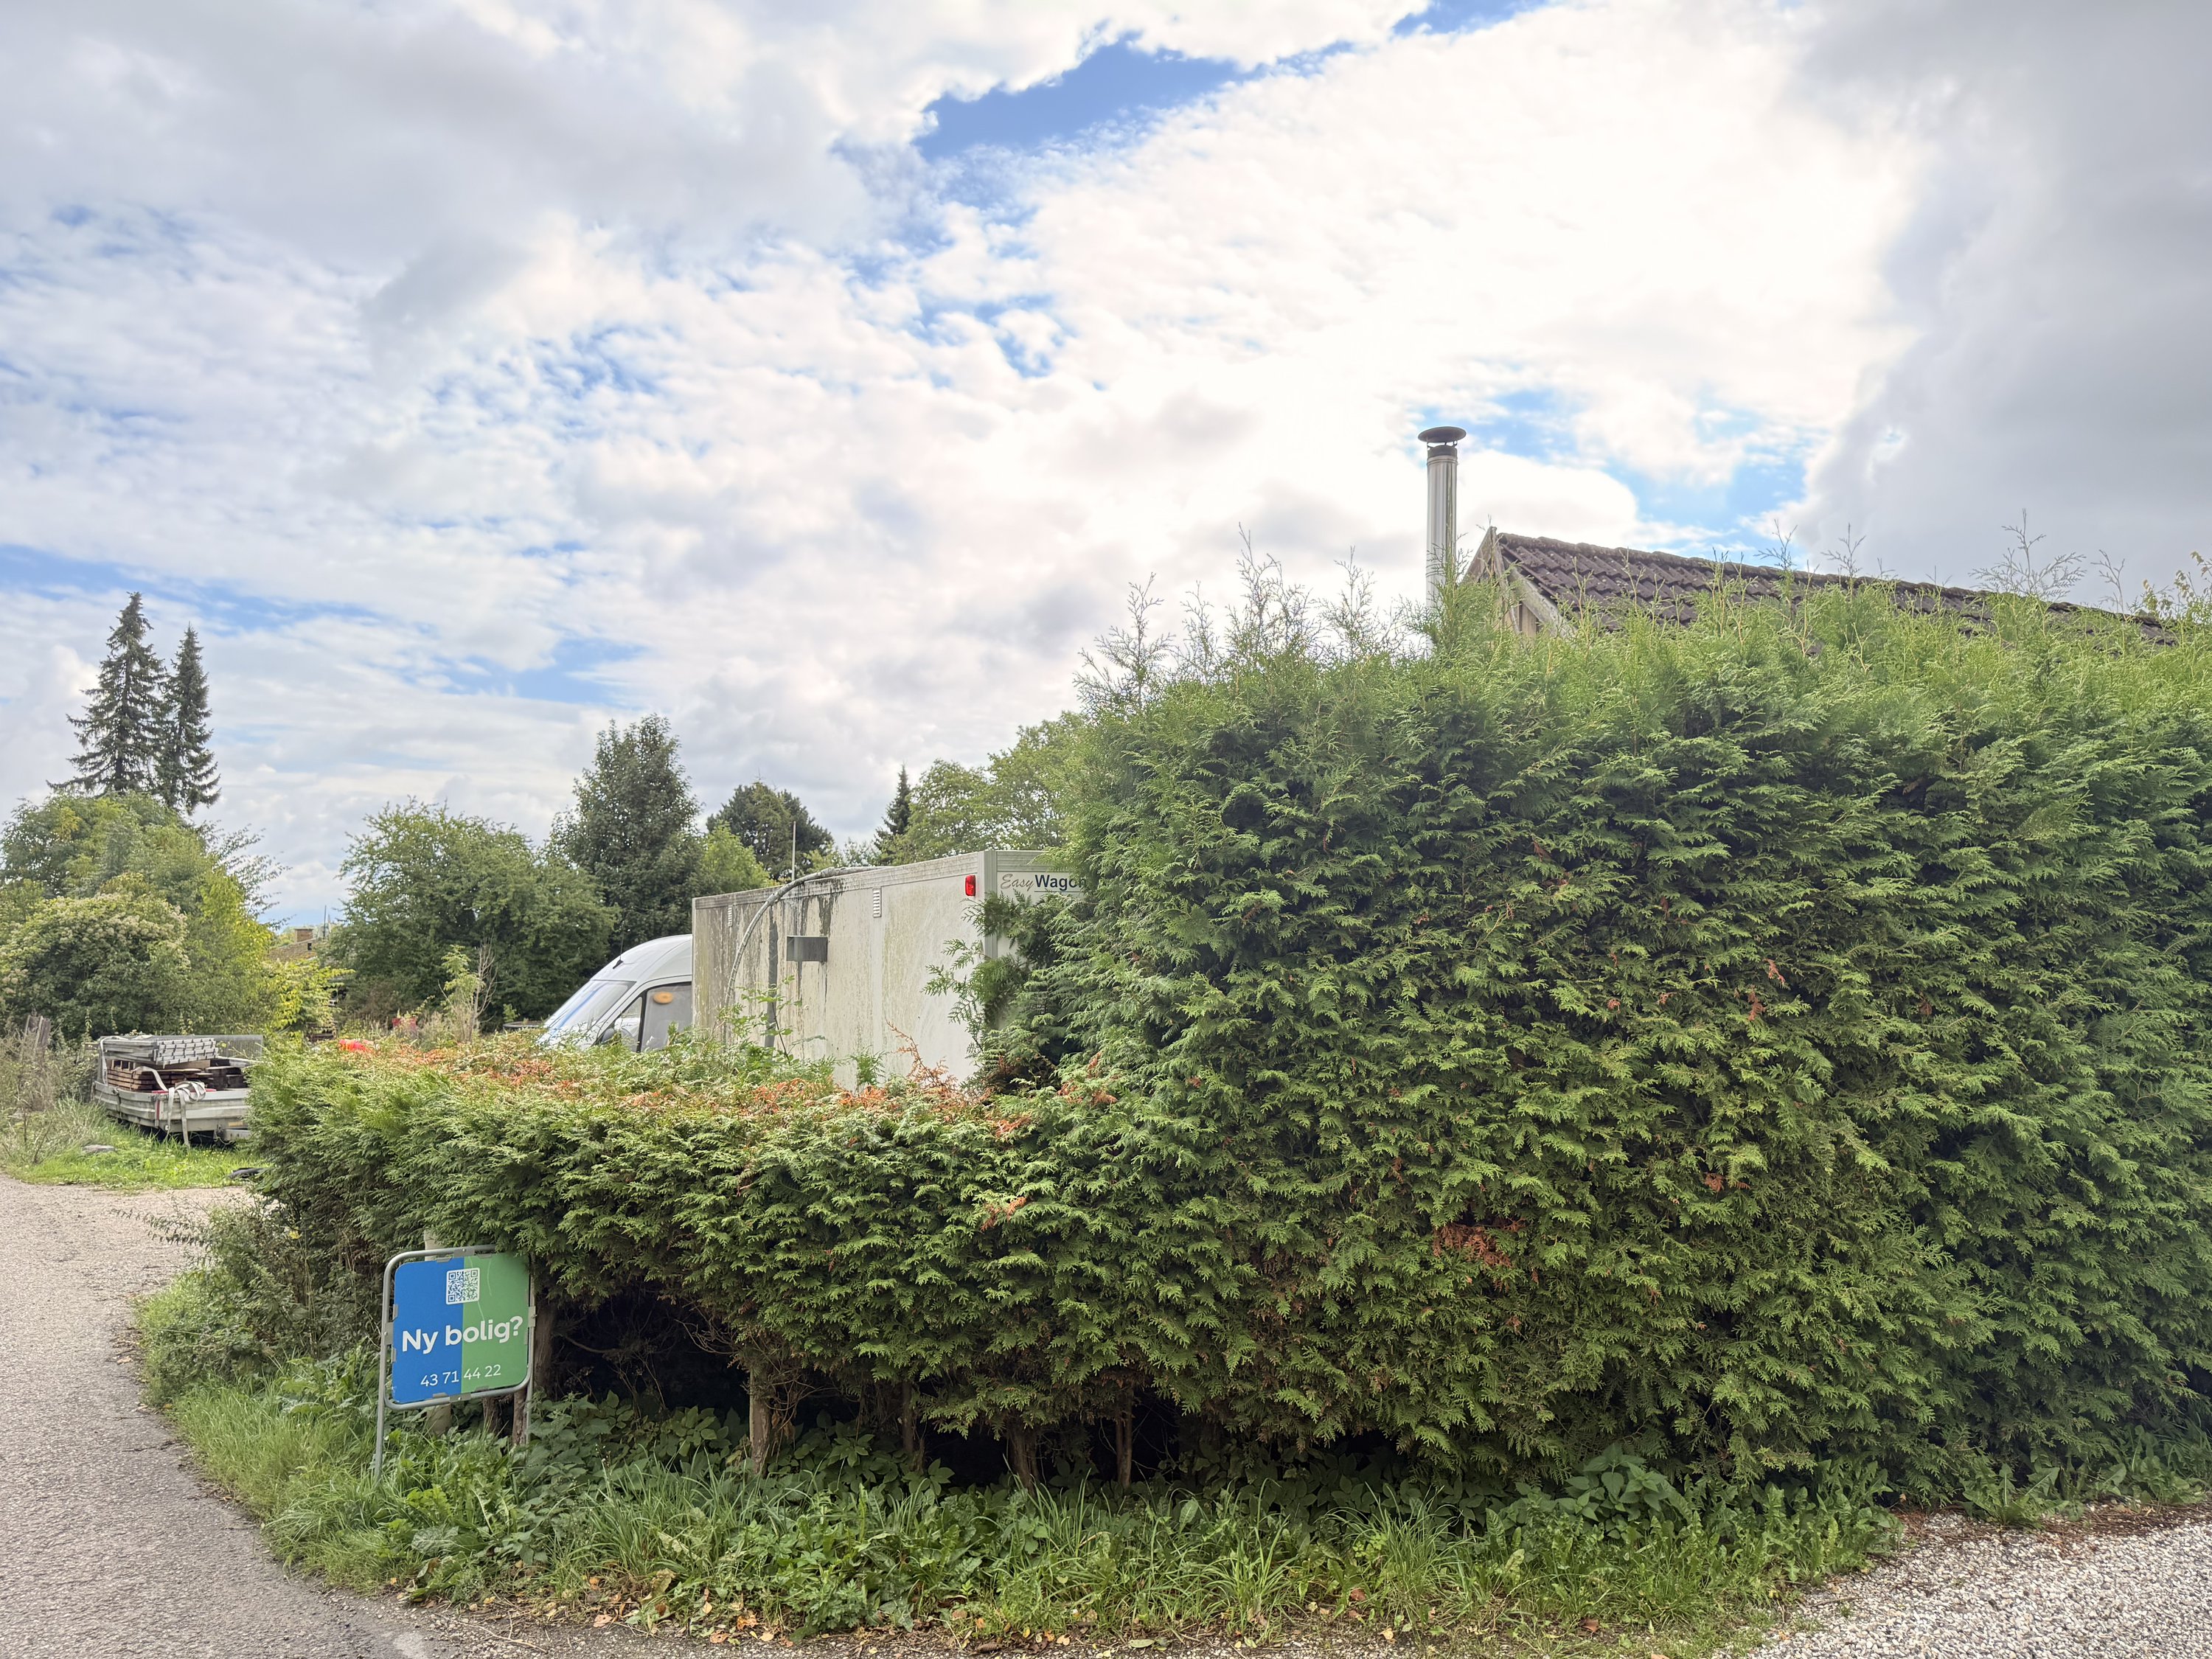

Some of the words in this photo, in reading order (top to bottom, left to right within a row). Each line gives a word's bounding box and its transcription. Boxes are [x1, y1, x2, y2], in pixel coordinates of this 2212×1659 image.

[402, 1329, 438, 1354] Ny
[445, 1316, 523, 1346] bolig?
[420, 1374, 438, 1387] 43
[443, 1371, 459, 1385] 71
[464, 1367, 481, 1380] 44
[484, 1364, 501, 1377] 22
